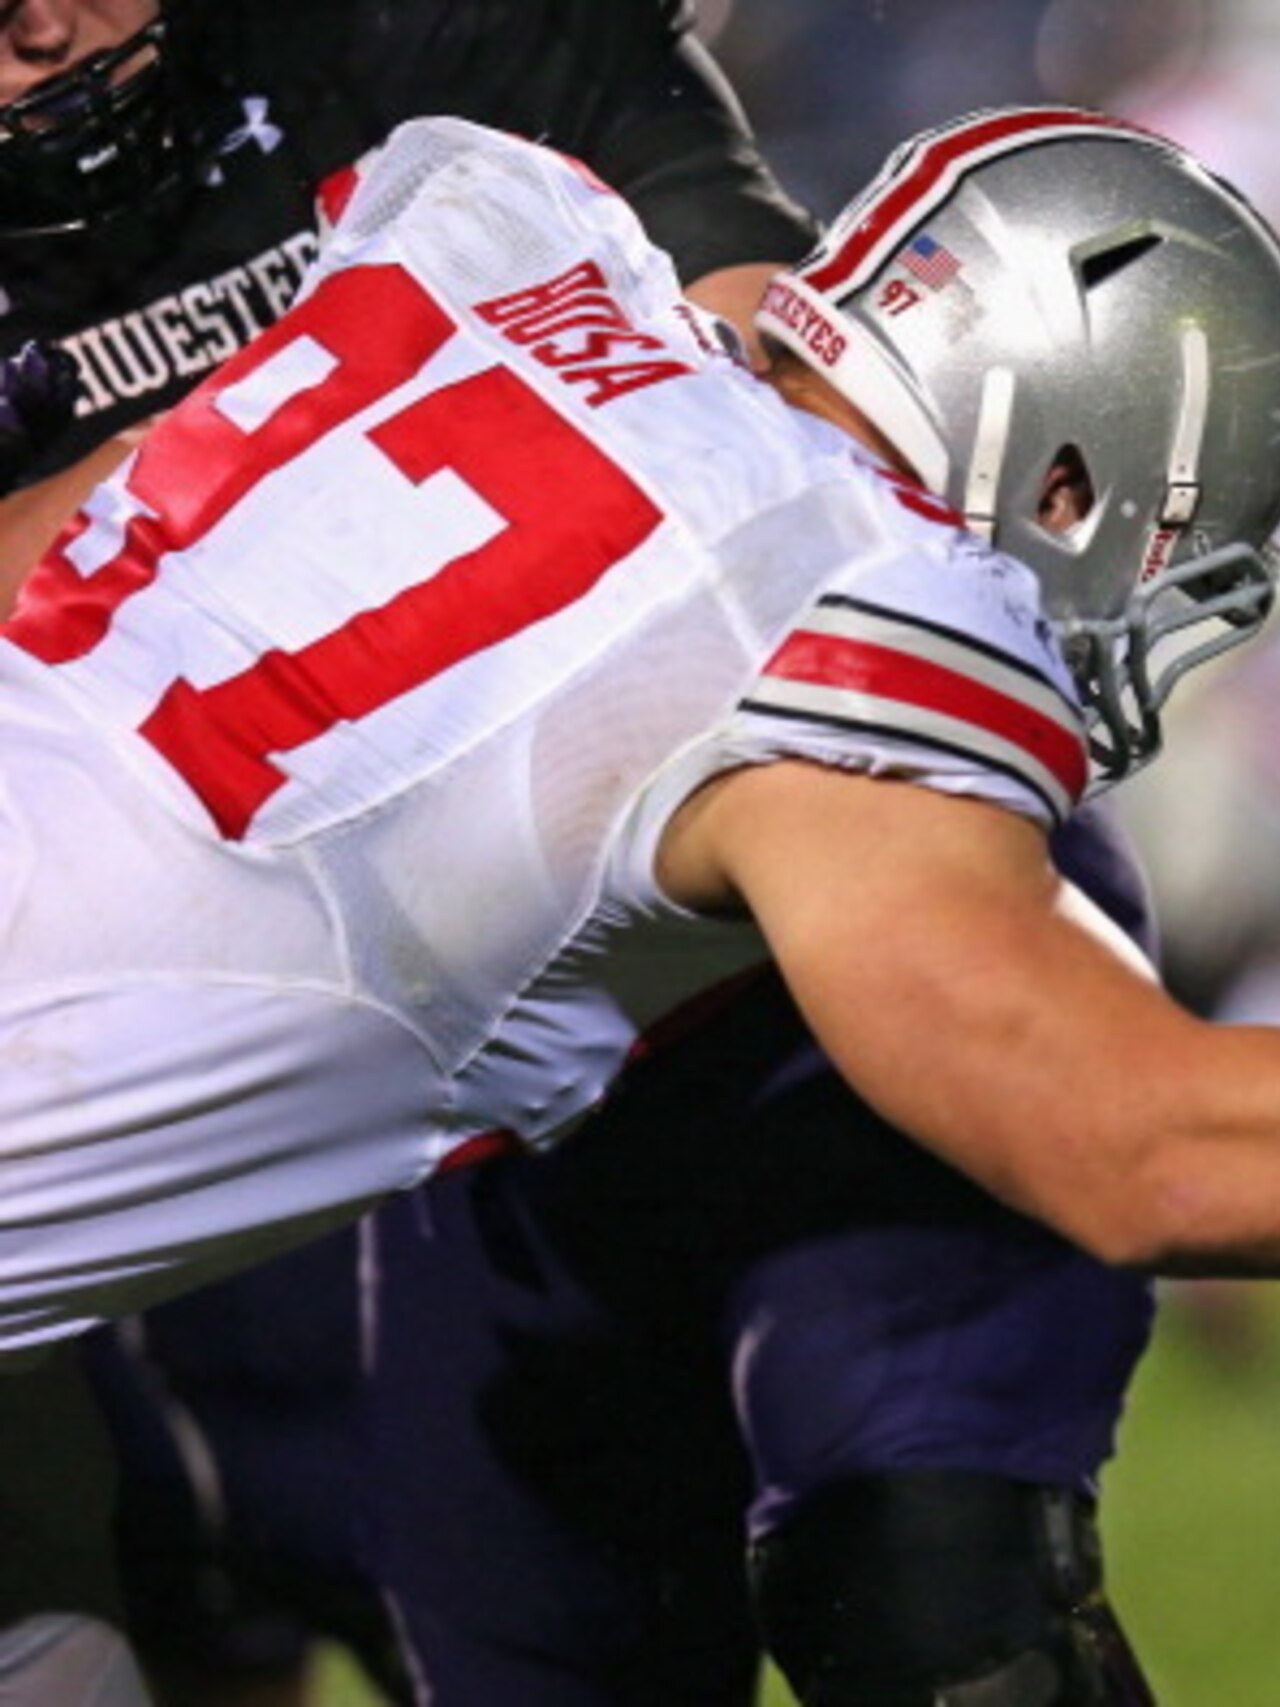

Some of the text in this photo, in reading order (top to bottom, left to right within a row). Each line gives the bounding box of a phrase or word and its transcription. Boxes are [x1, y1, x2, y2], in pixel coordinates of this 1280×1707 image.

[470, 258, 698, 409] BOSA
[878, 279, 919, 317] 97
[2, 262, 665, 842] 97
